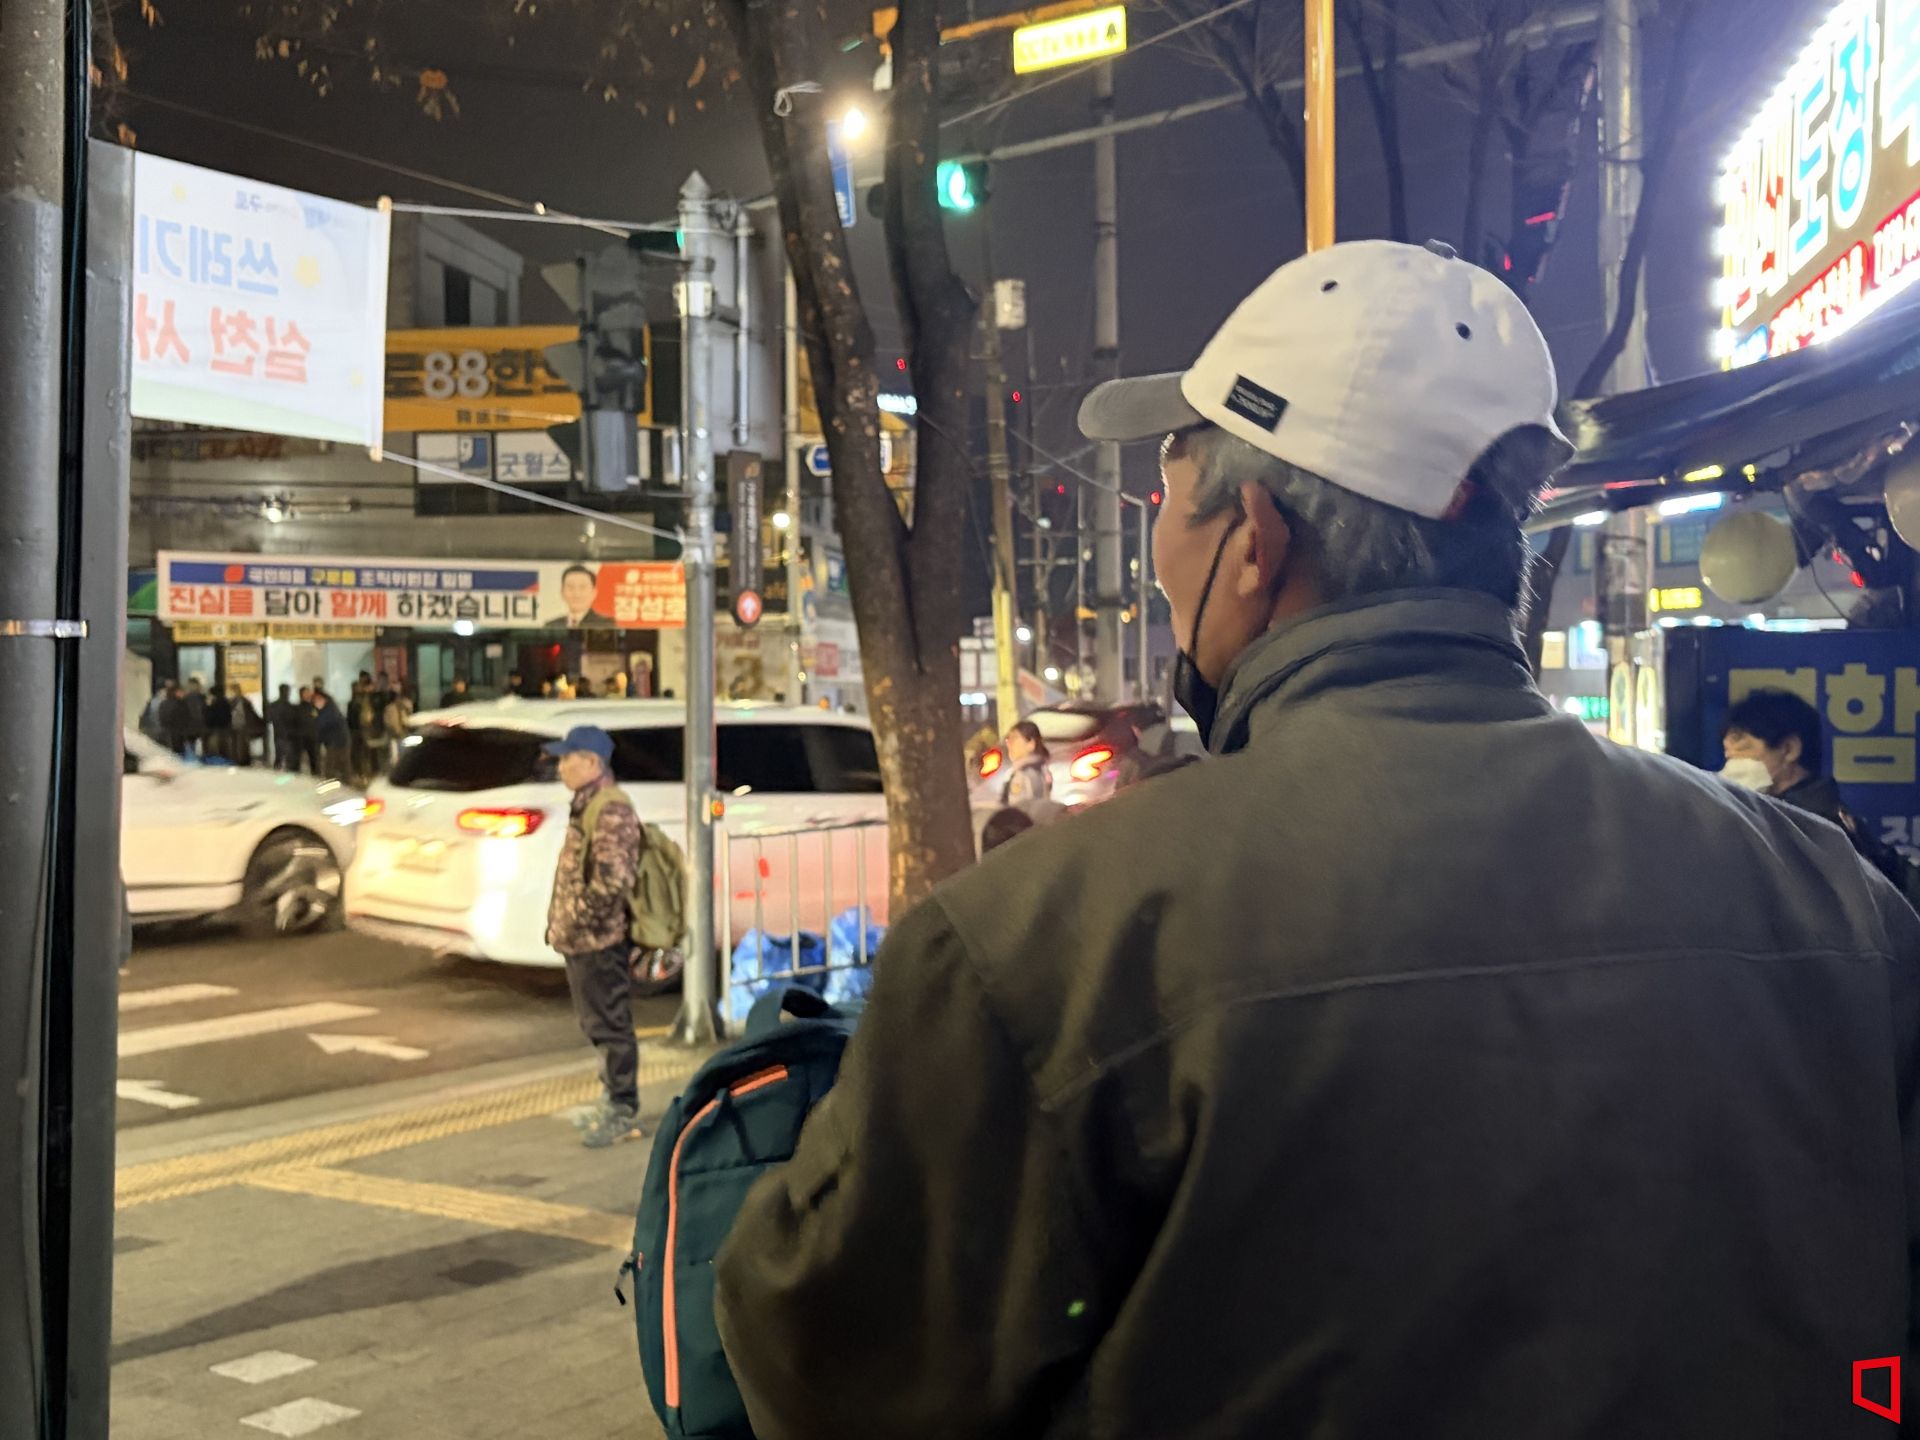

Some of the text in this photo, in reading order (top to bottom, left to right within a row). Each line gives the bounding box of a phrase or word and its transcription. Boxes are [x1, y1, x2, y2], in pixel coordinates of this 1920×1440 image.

[169, 587, 538, 620] 진실을 담아 함께 하겠습니다
